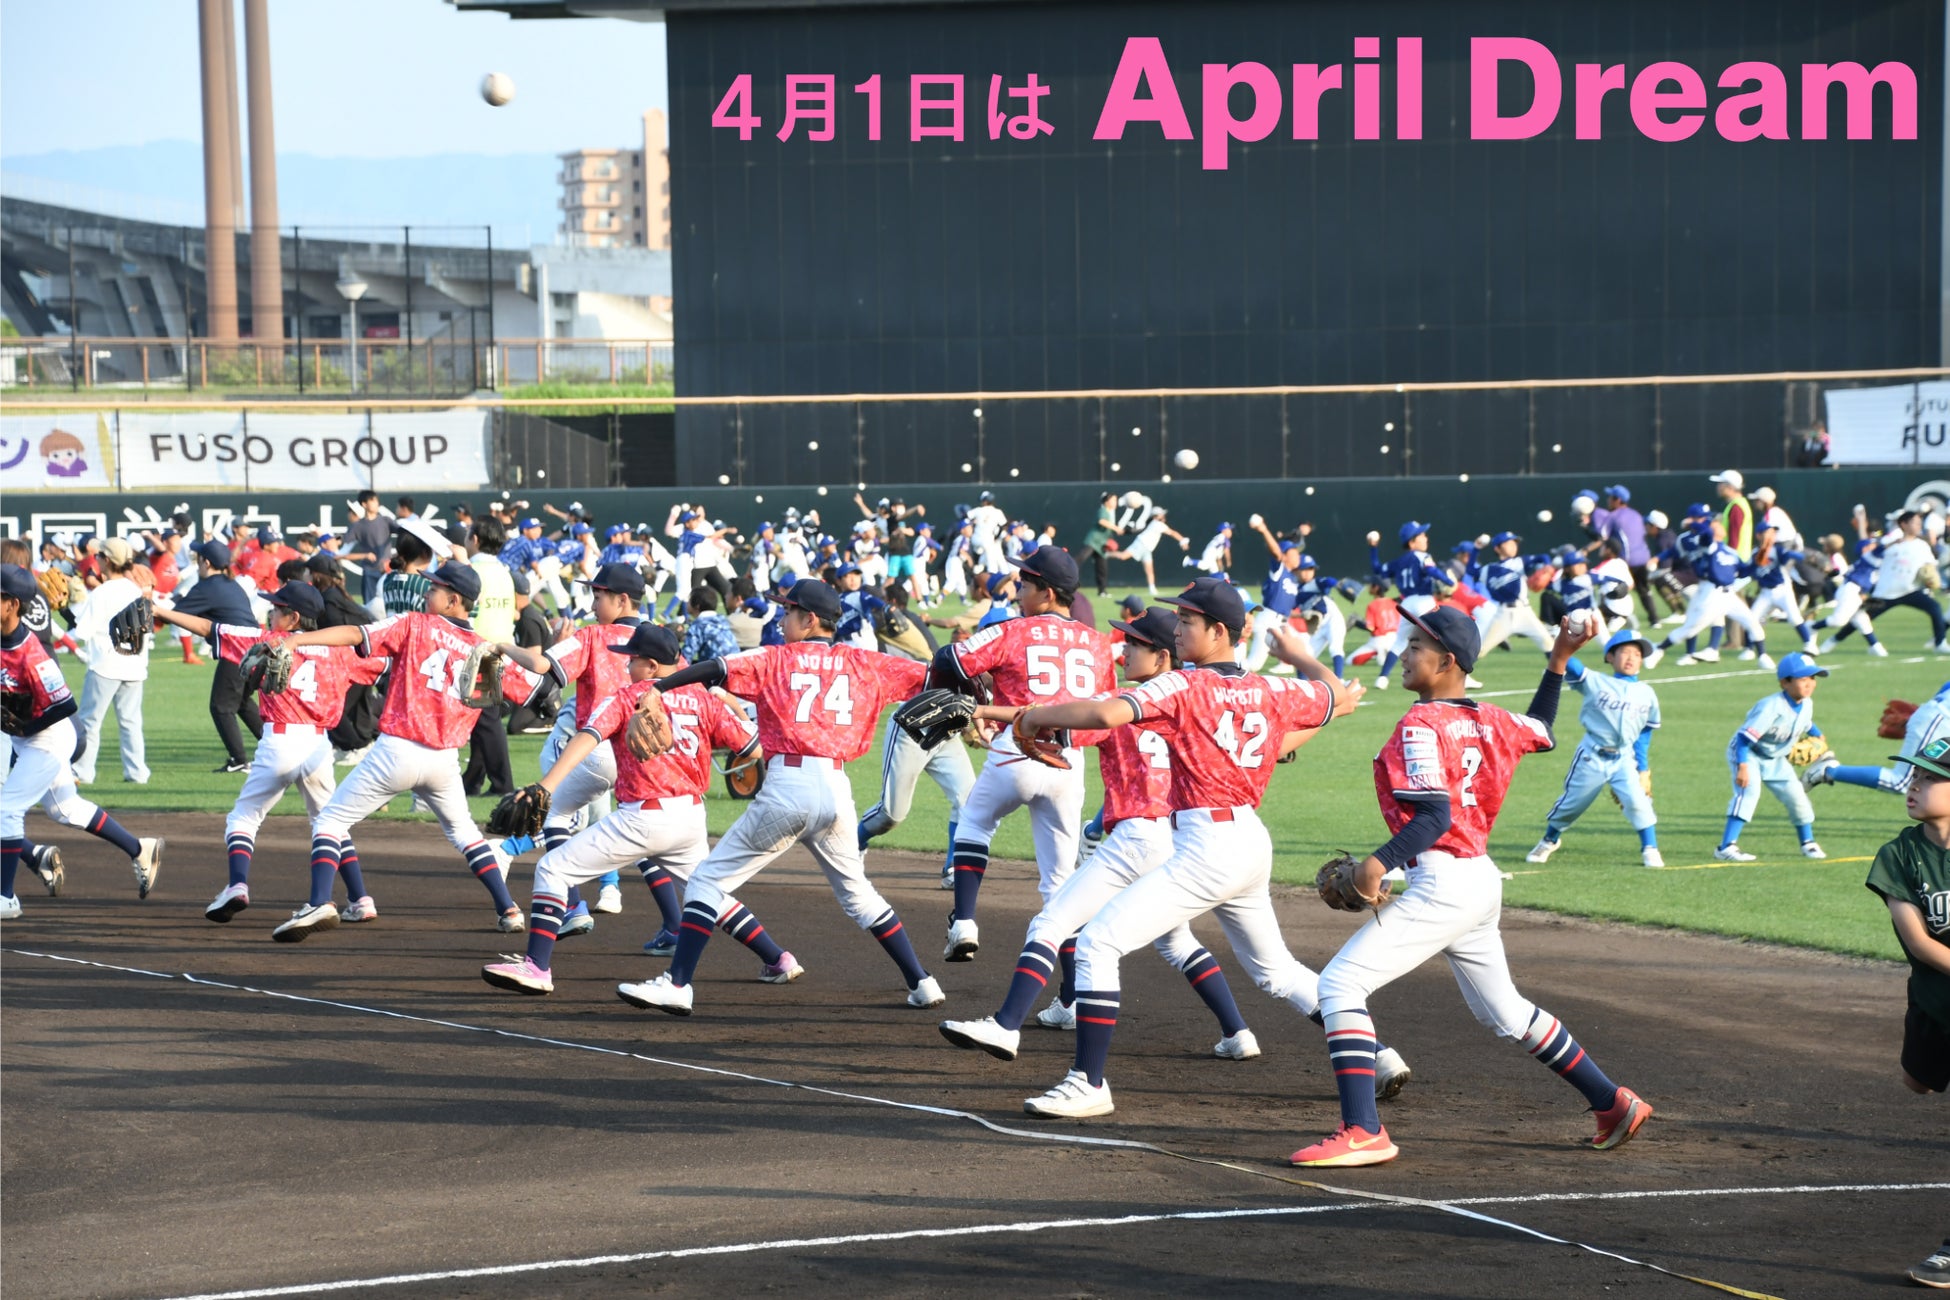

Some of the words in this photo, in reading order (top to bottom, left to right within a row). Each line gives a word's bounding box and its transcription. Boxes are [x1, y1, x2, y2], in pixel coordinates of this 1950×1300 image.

[149, 433, 274, 466] FUSO
[288, 434, 449, 468] GROUP
[1031, 624, 1090, 645] SENA
[797, 653, 844, 672] NOBU
[1025, 644, 1097, 699] 56
[790, 671, 855, 726] 74
[1212, 709, 1268, 769] 42
[1461, 745, 1483, 809] 2
